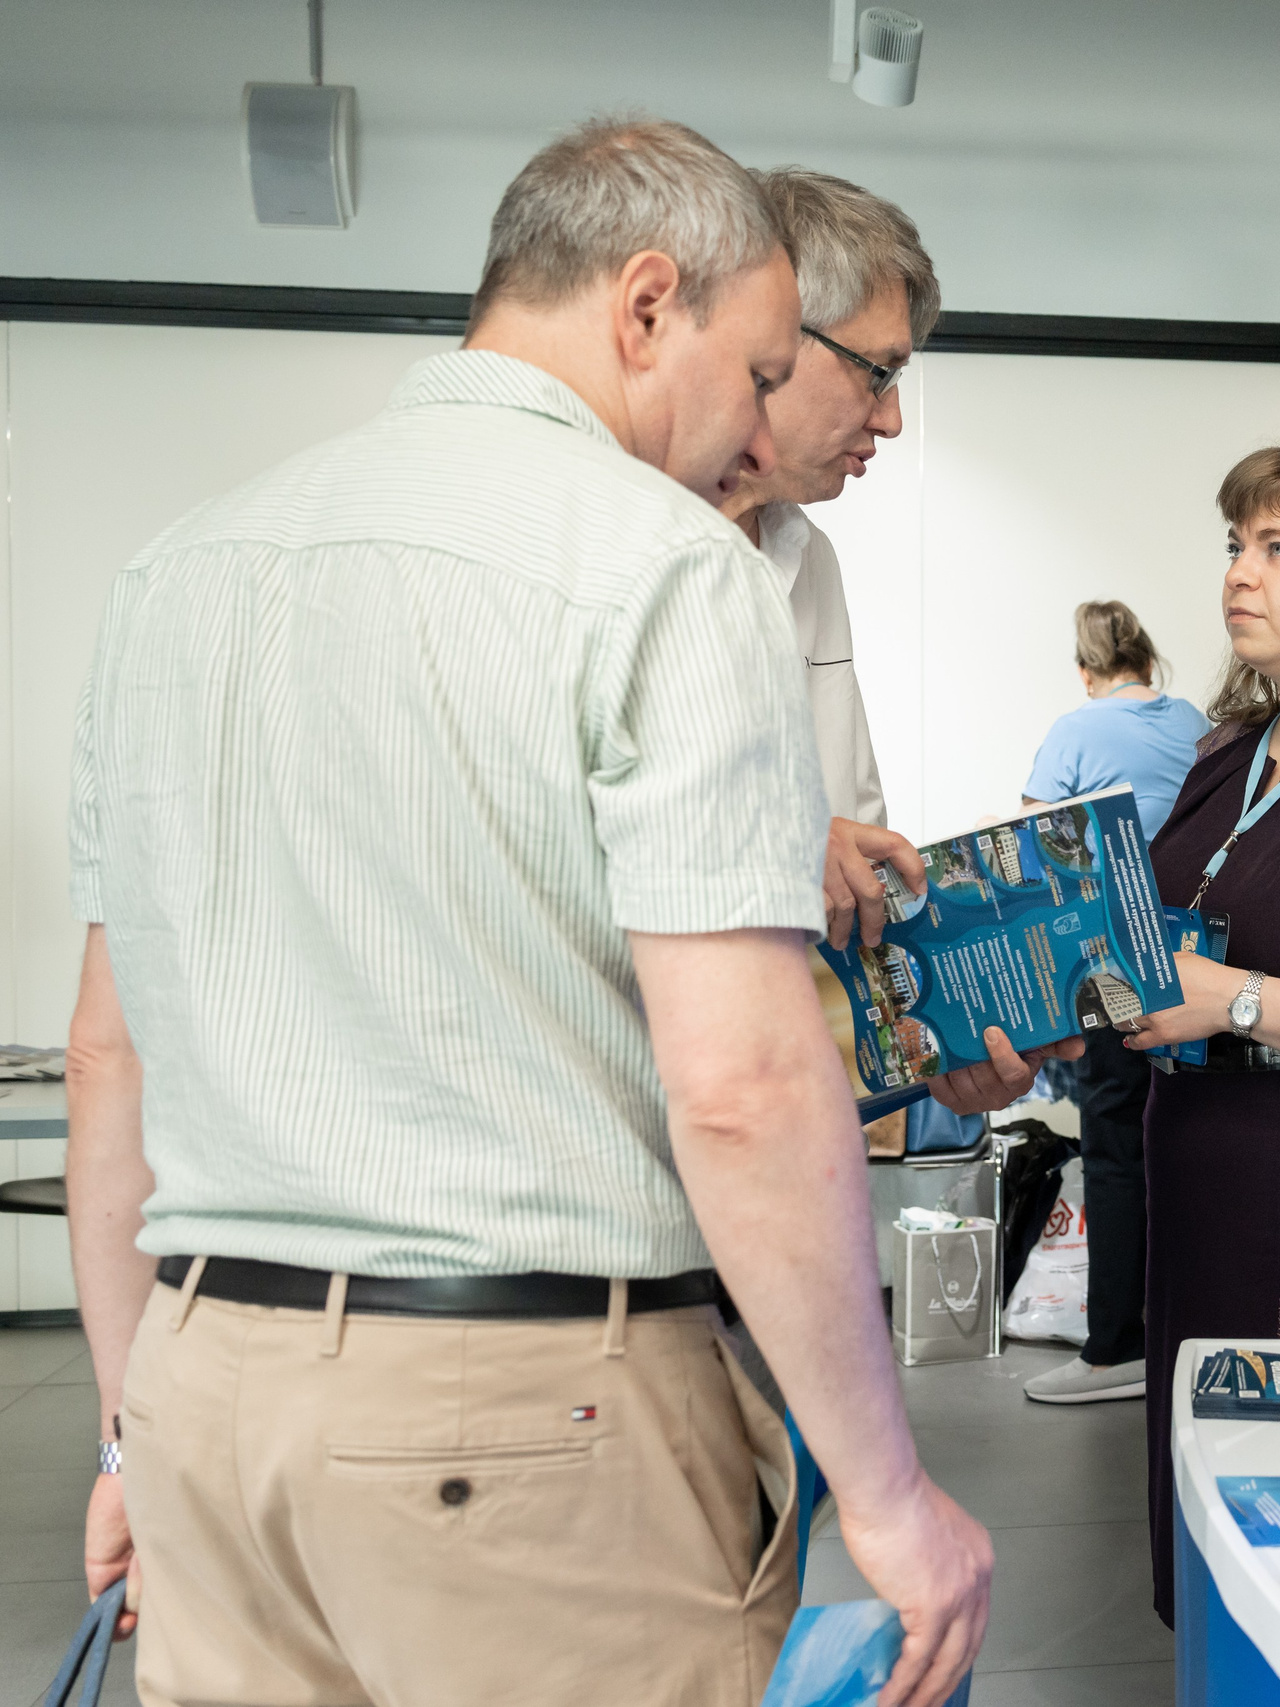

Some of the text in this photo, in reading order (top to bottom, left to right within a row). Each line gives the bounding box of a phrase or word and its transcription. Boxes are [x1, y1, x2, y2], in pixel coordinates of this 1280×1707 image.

[1038, 923, 1056, 973] Мы предлагаем
[1104, 834, 1118, 873] Министерства
[1127, 920, 1139, 951] Российской
[1136, 952, 1146, 981] Федерации
[1118, 818, 1165, 989] «Национальный медицинский исследовательский центр
[1118, 859, 1134, 902] реабилитации
[1132, 908, 1147, 953] курортологии»
[1127, 820, 1172, 982] Федеральное государственное бюджетное учреждение
[1026, 934, 1048, 1000] санаторно-курортное
[1045, 1001, 1057, 1029] лечение!
[1032, 926, 1060, 1016] медицинскую реабилитацию
